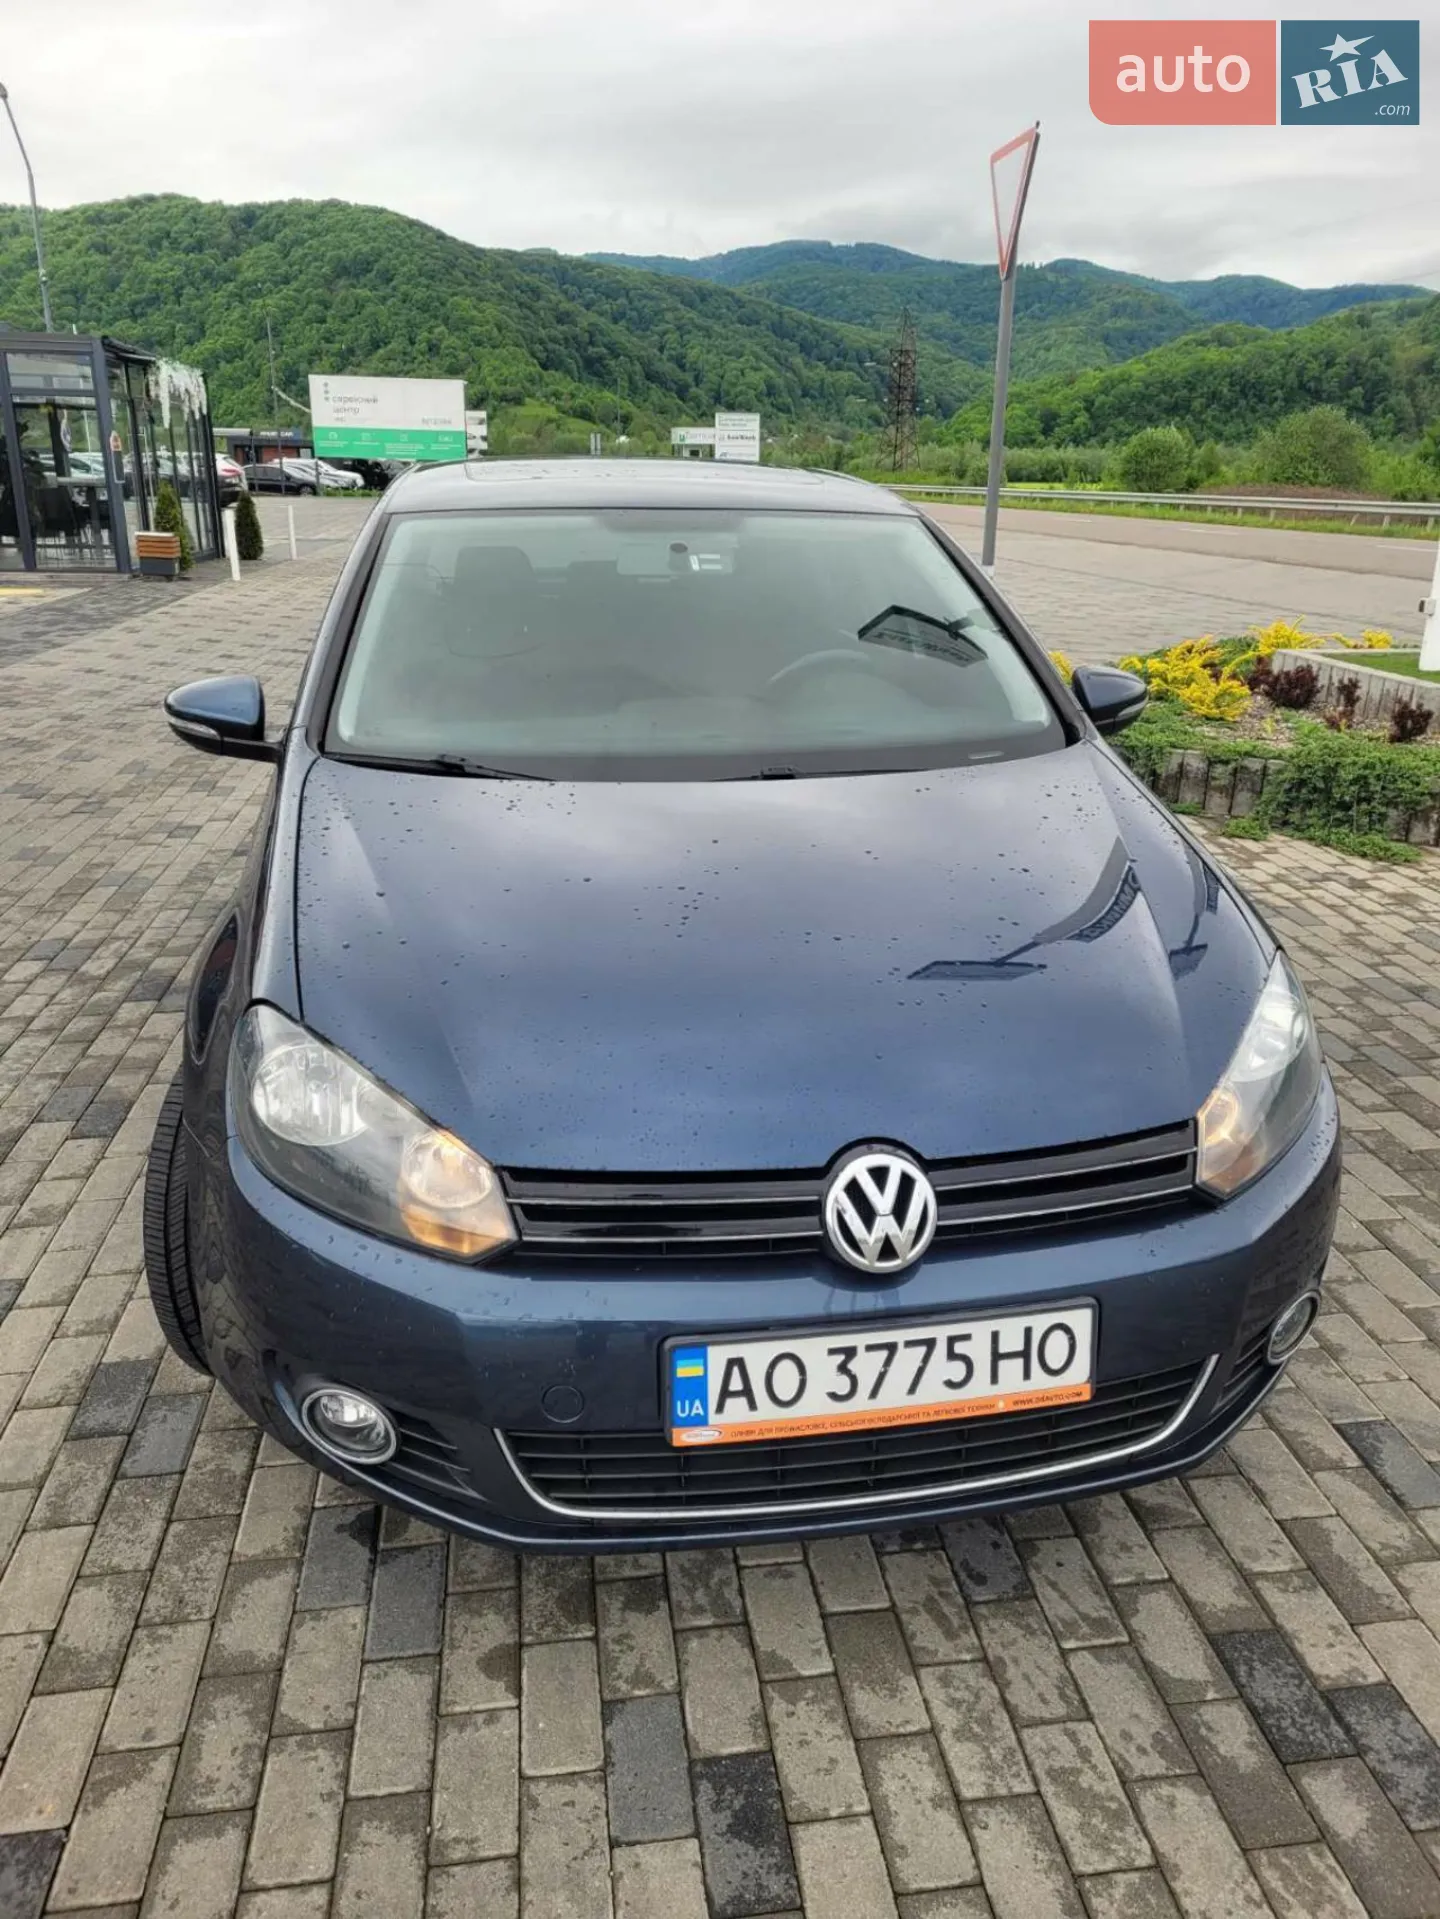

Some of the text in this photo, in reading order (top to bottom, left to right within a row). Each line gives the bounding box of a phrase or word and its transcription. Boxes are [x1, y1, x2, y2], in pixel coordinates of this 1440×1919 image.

[715, 1321, 1077, 1416] AO 3775 HO
[677, 1399, 705, 1418] UA
